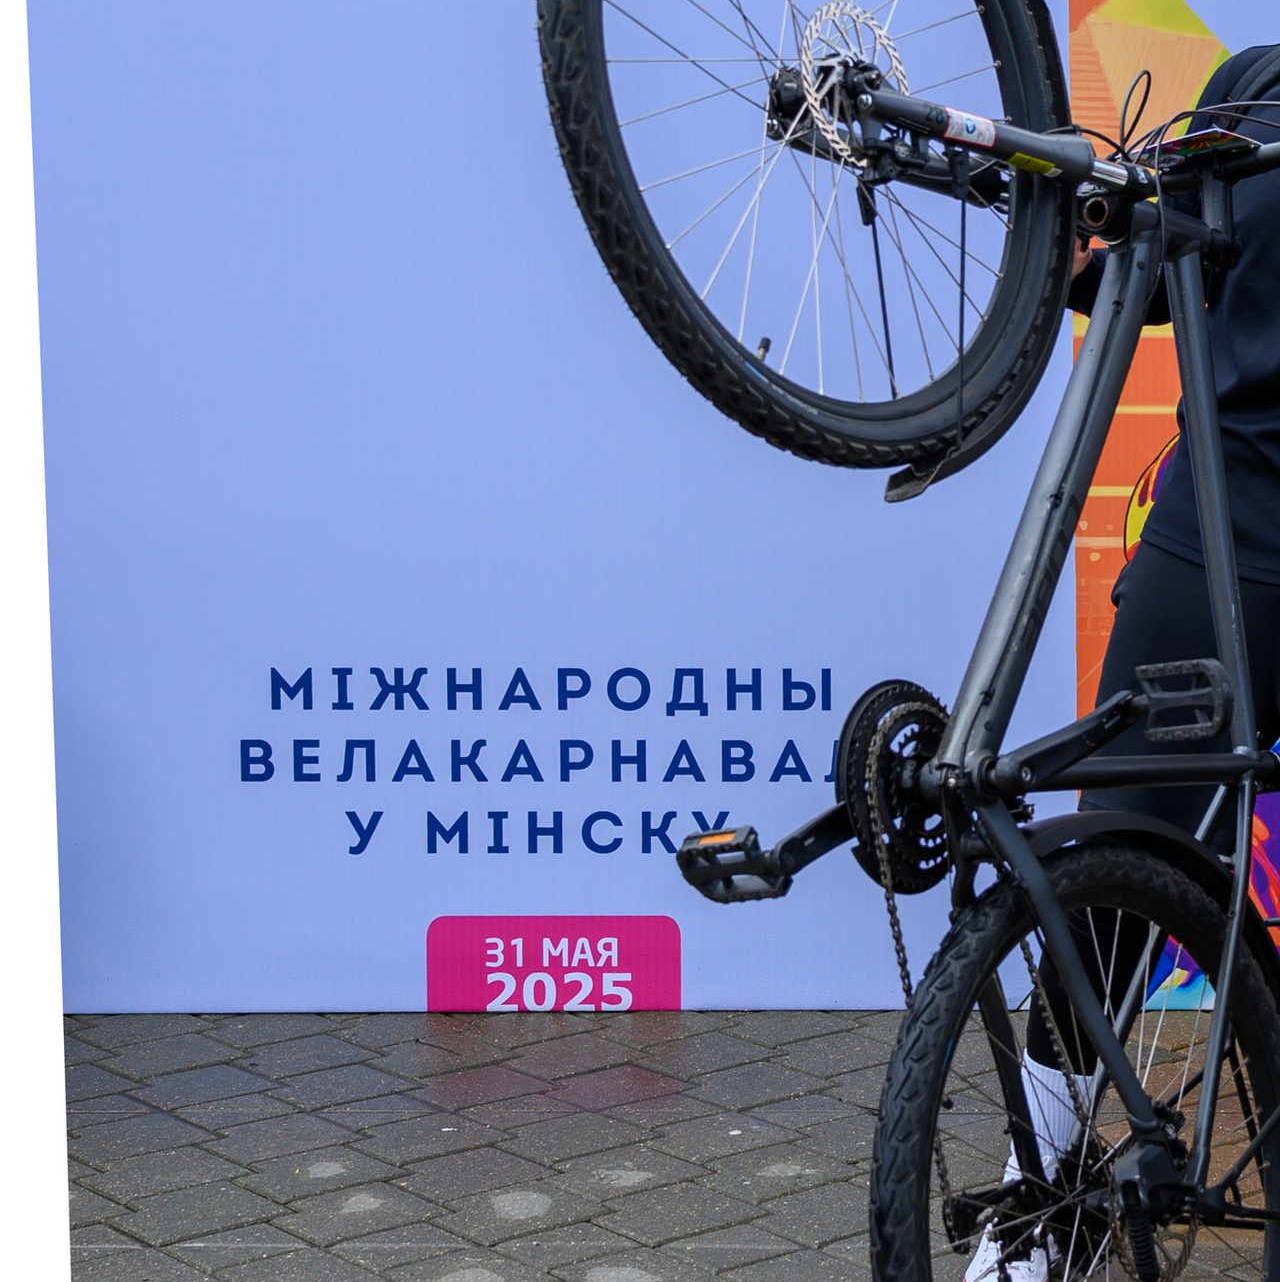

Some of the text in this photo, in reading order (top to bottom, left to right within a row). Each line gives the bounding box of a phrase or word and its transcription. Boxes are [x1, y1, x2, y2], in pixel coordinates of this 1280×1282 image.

[270, 667, 832, 716] МІЖНАРОДНЫ
[240, 739, 837, 783] ВЕЛАКАРНАВА
[345, 811, 384, 855] У
[485, 937, 618, 967] 31 МАЯ
[486, 972, 633, 1011] 2025
